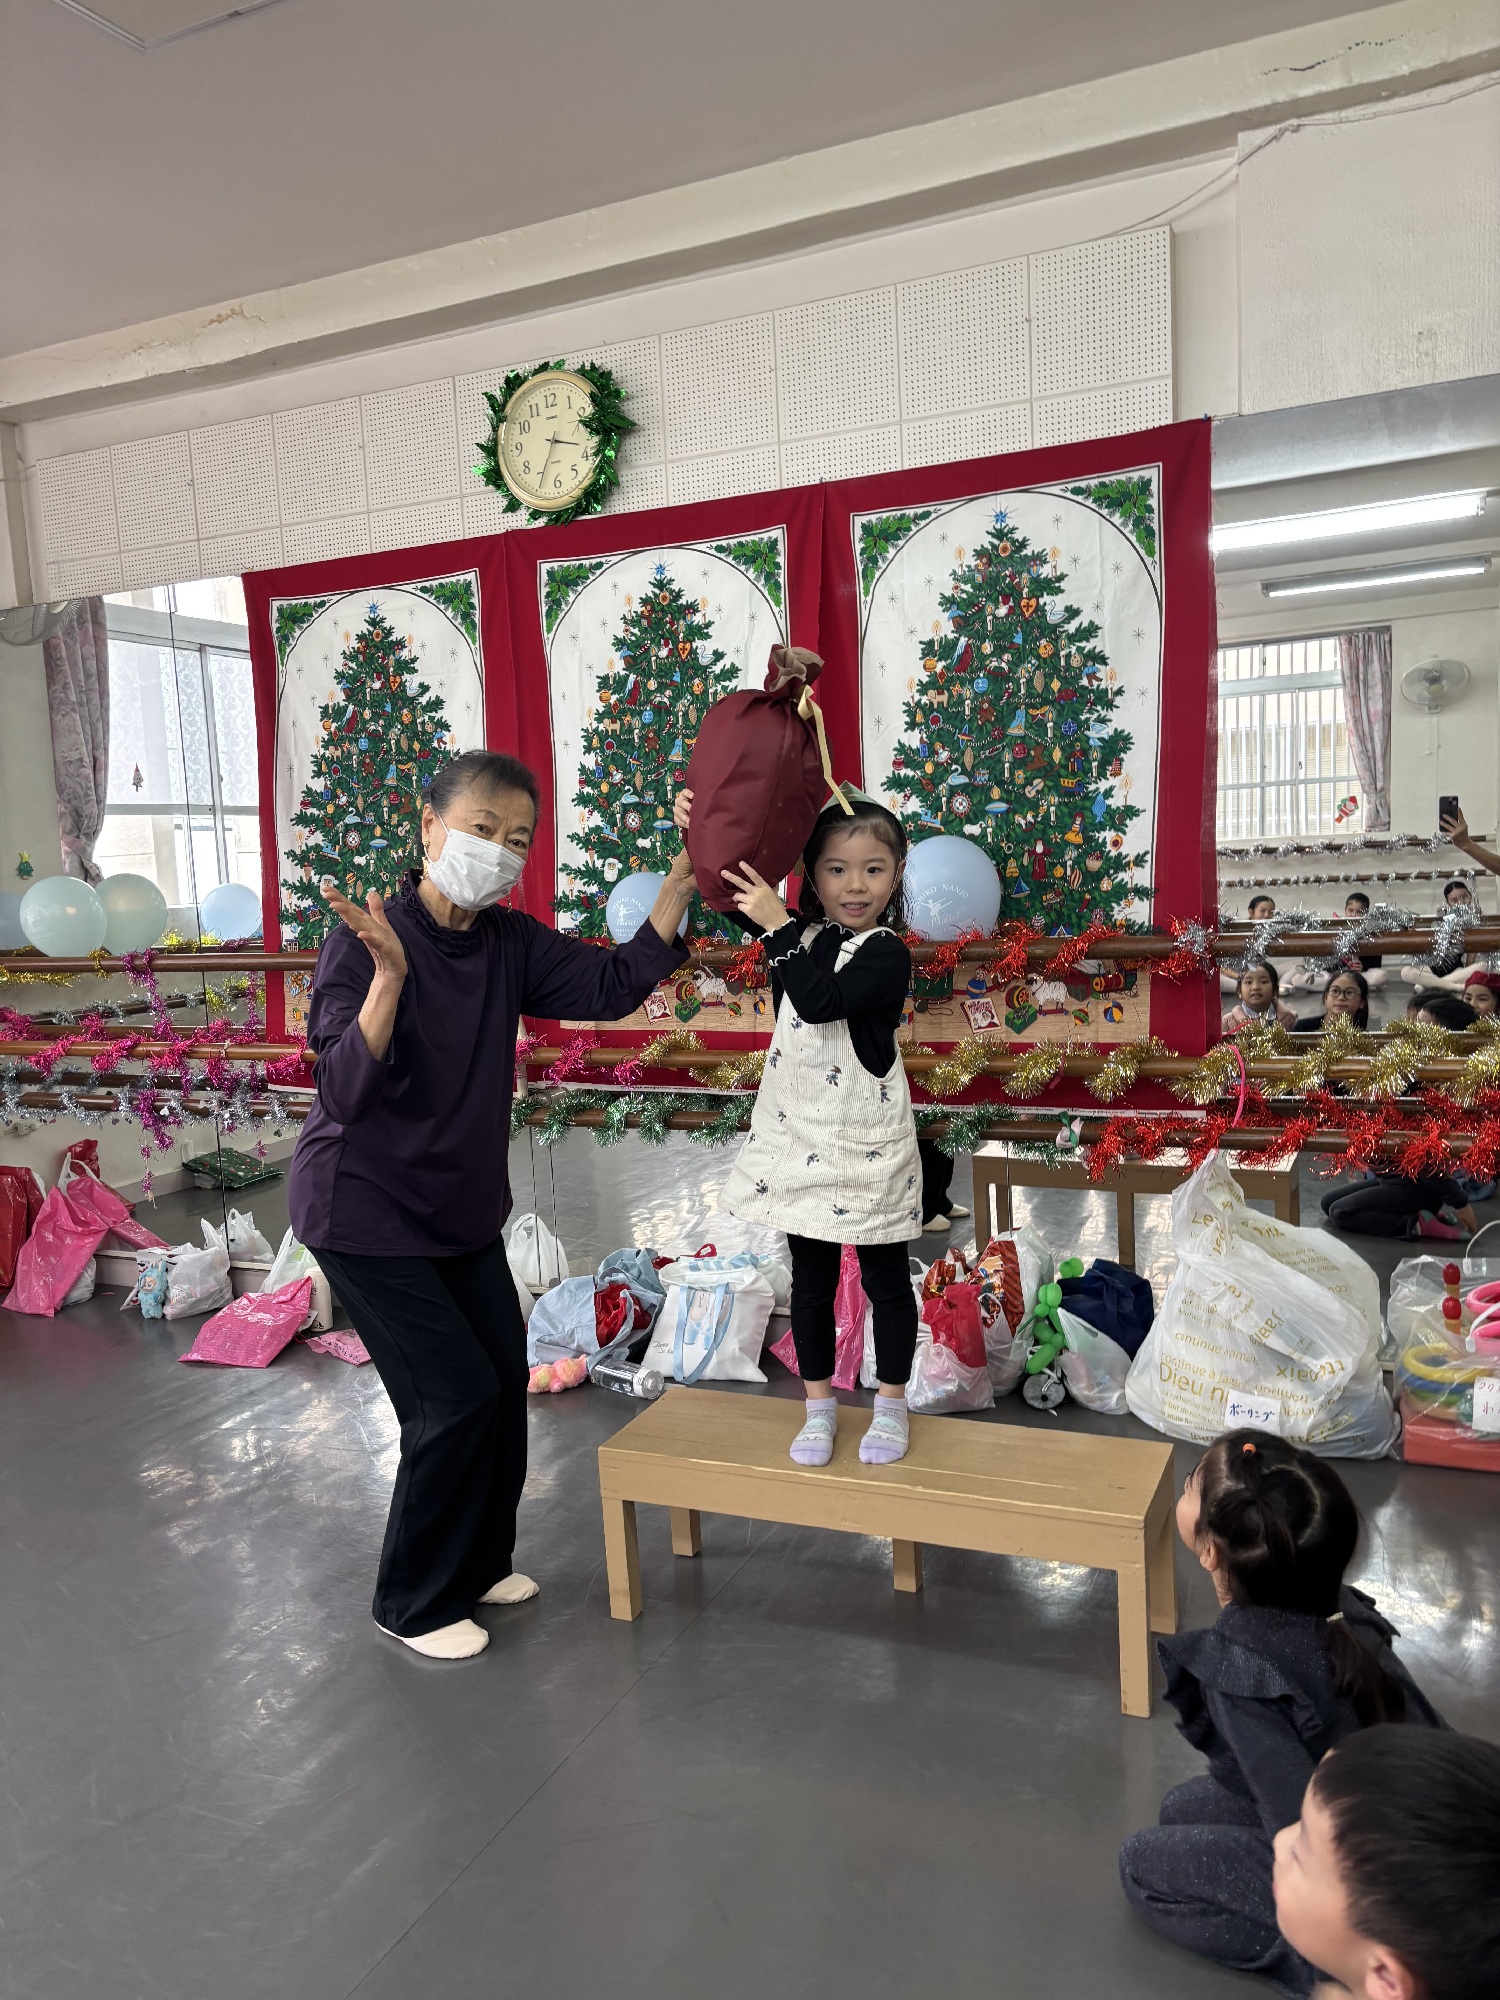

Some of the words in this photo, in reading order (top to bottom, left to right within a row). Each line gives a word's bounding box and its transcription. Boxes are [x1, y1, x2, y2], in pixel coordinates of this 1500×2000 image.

[543, 392, 557, 409] 12
[567, 395, 573, 410] 1
[529, 403, 541, 419] 11
[518, 419, 531, 436] 10
[515, 442, 523, 458] 9
[581, 445, 591, 461] 4
[523, 460, 531, 475] 8
[570, 463, 579, 480] 5
[553, 473, 562, 489] 6
[942, 883, 969, 898] NANJO
[1159, 1361, 1204, 1397] Dieu
[1229, 1403, 1275, 1423] ボーリング
